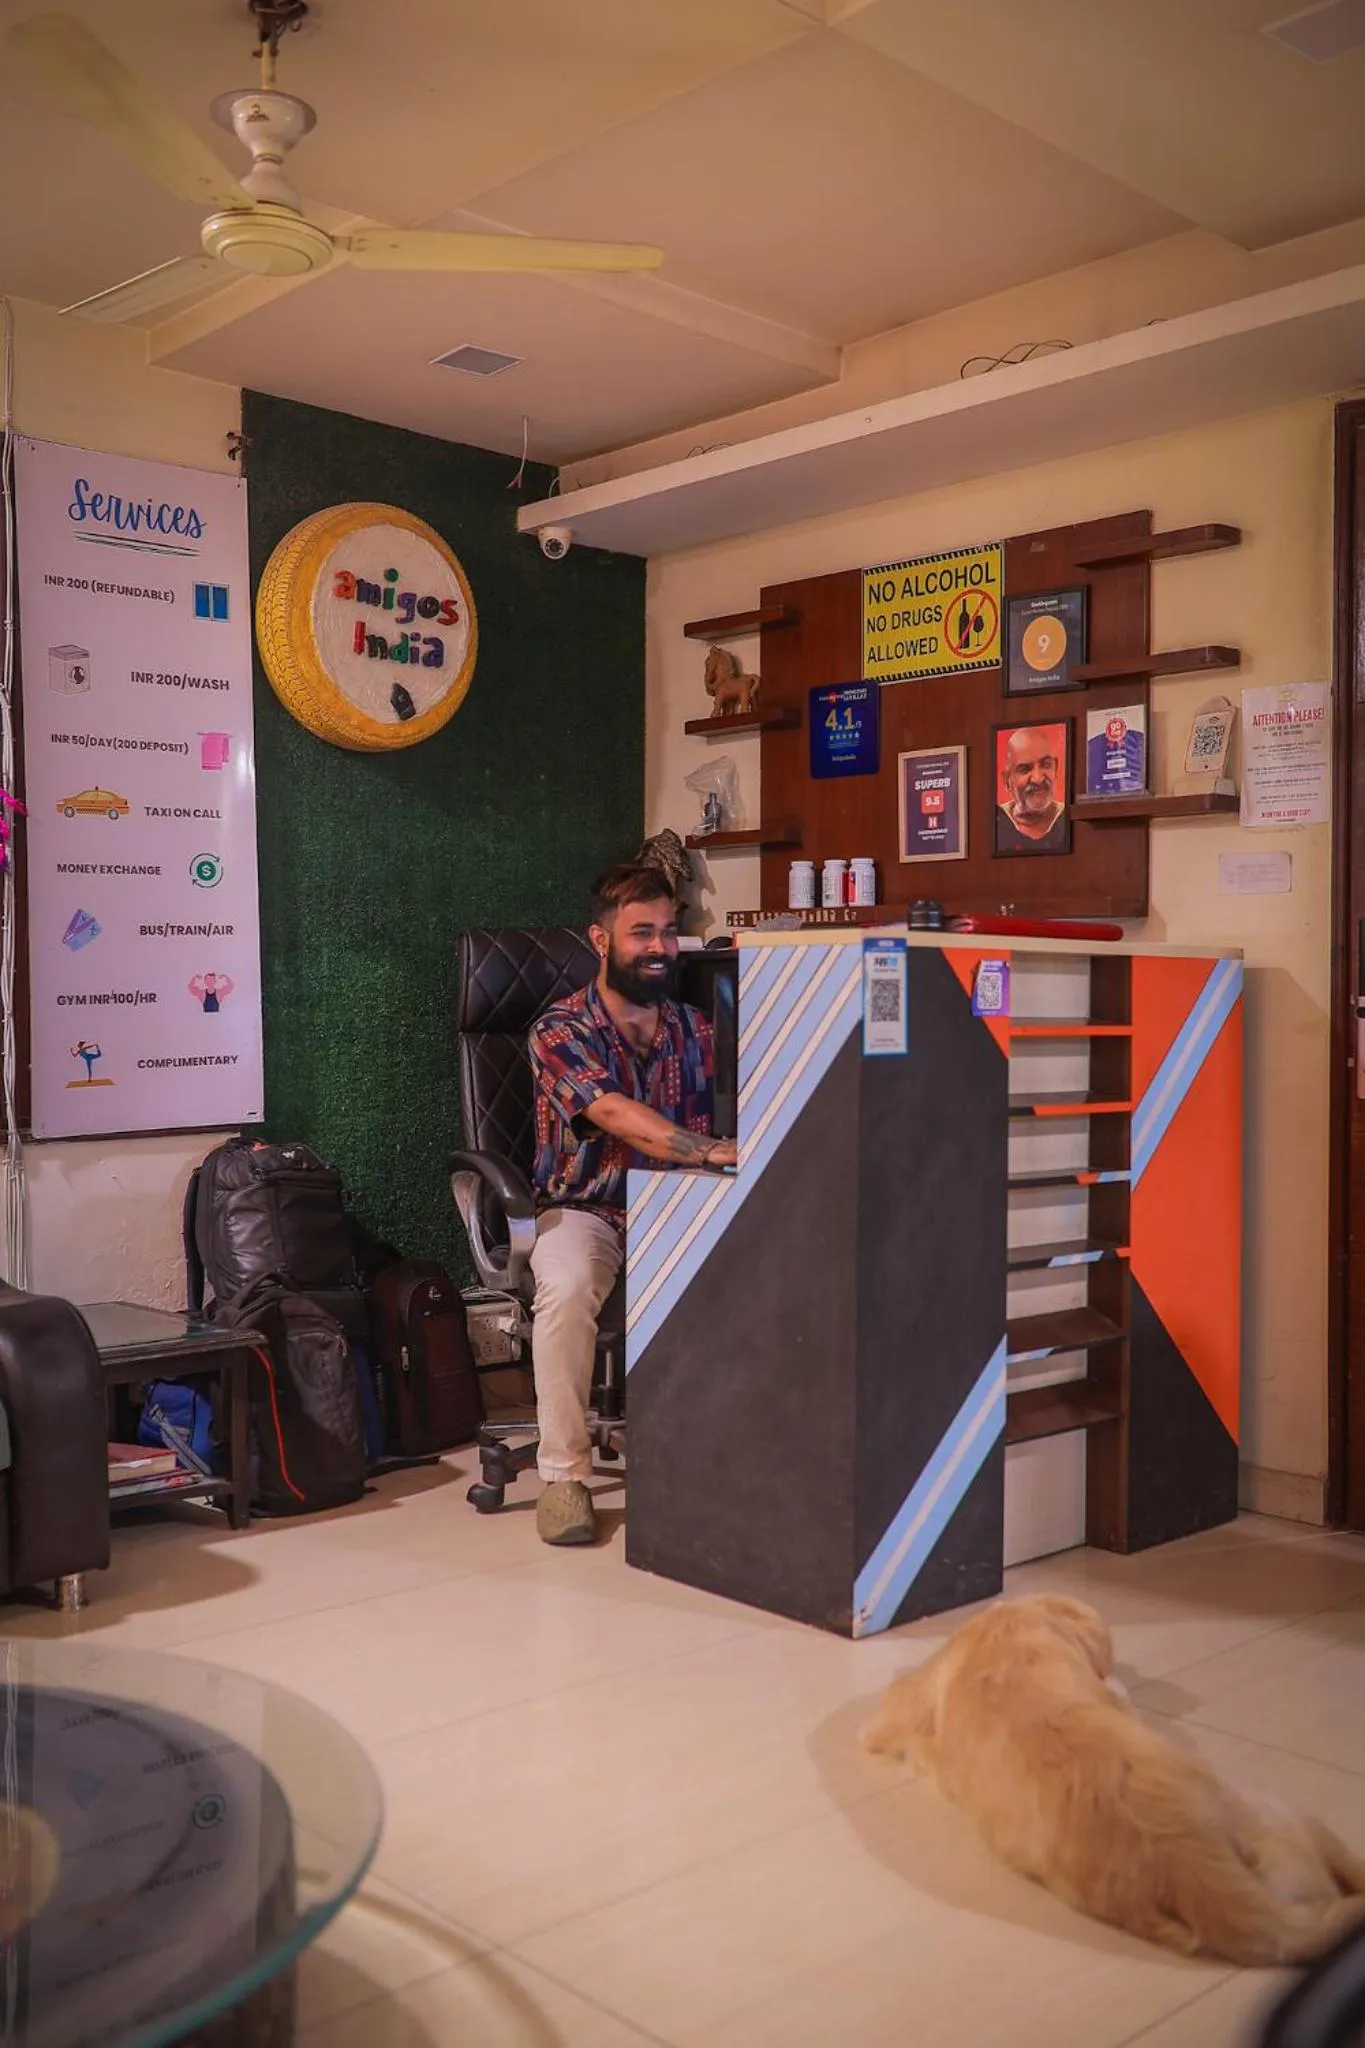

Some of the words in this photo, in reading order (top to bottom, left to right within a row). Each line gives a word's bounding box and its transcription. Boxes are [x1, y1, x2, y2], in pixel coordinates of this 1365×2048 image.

[67, 478, 208, 539] Services
[44, 574, 65, 587] INR
[66, 577, 89, 590] 200
[91, 579, 175, 604] (REFUNDABLE)
[868, 580, 896, 605] NO
[901, 561, 996, 601] ALCOHOL
[333, 567, 460, 626] amigos
[866, 615, 887, 634] NO
[891, 604, 943, 631] DRUGS
[353, 620, 445, 669] India
[867, 636, 939, 664] ALLOWED
[1038, 634, 1050, 653] 9
[130, 671, 154, 685] INR
[156, 673, 230, 691] 200/WASH
[1252, 711, 1292, 727] ATTENTION
[51, 733, 70, 744] INR
[139, 741, 190, 755] DEPOSIT)
[914, 778, 951, 790] SUPERB
[143, 806, 172, 818] TAXI
[173, 807, 191, 818] ON
[192, 809, 222, 820] CALL
[56, 863, 97, 874] MONEY
[99, 864, 162, 876] EXCHANGE
[139, 922, 234, 938] BUS/TRAIN/AIR
[56, 994, 87, 1006] GYM
[89, 993, 110, 1005] INR
[136, 1055, 238, 1070] COMPLIMENTARY
